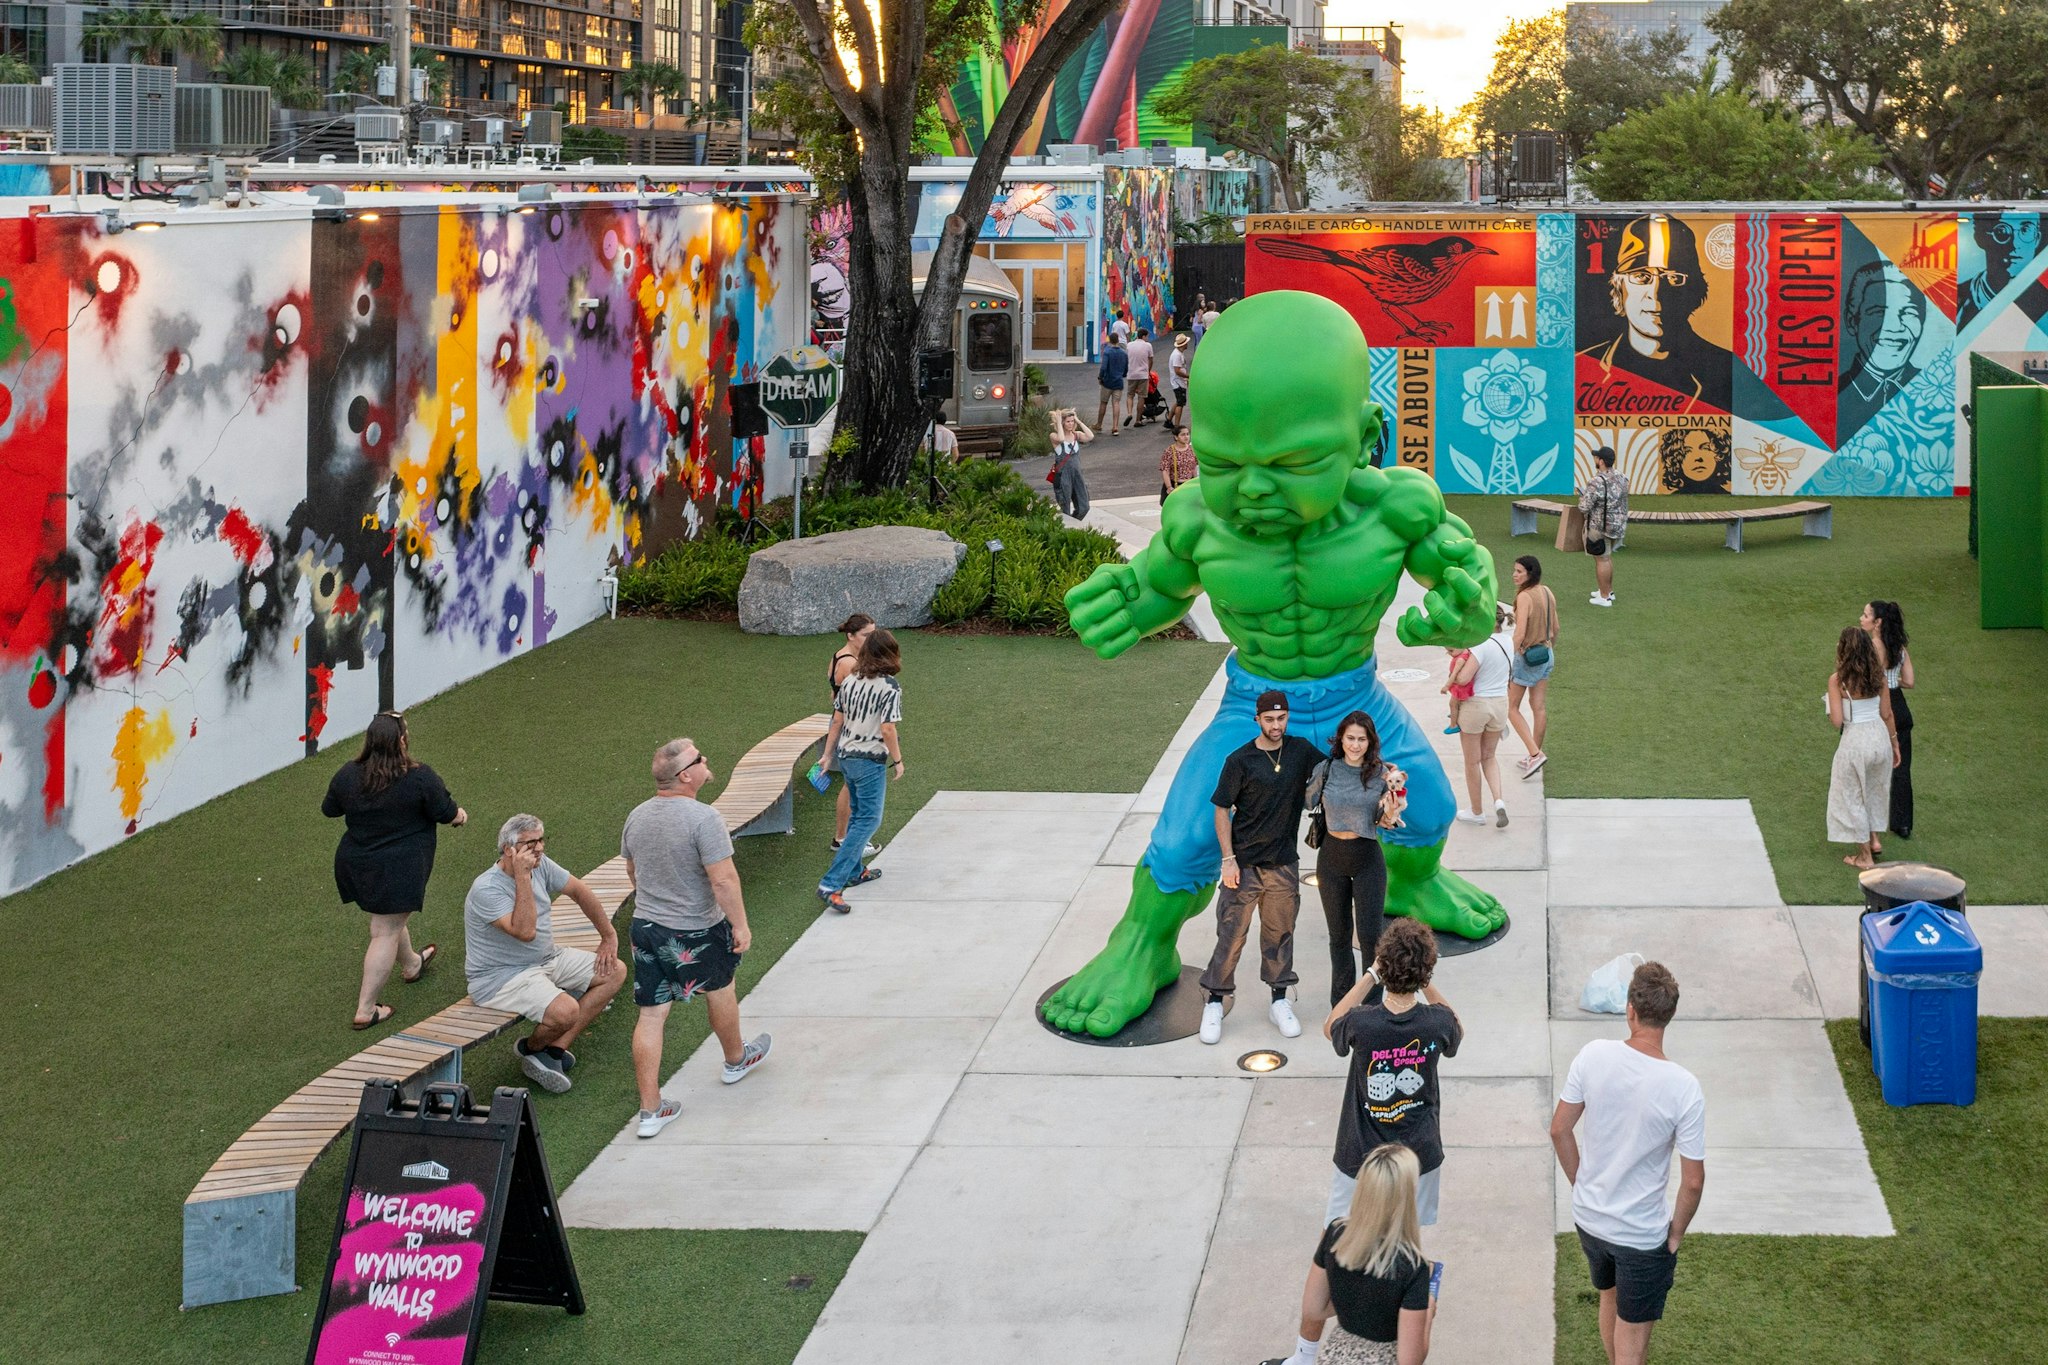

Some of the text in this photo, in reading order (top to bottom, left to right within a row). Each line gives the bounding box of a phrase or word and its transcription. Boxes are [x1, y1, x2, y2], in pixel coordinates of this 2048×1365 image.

[1253, 221, 1315, 231] FRAGILE
[1320, 221, 1373, 231] CARGO
[1383, 220, 1443, 230] HANDLE
[1448, 220, 1487, 230] WITH
[1492, 220, 1532, 230] CARE
[1586, 242, 1605, 273] 1
[1777, 224, 1836, 385] EYES OPEN
[767, 373, 832, 402] DREAM
[1577, 381, 1685, 412] Welcome
[1402, 349, 1429, 473] SE ABOVE
[1578, 415, 1732, 428] TONY GOLDMAN
[1372, 1048, 1406, 1060] DELTA
[1920, 995, 1946, 1097] RECYCLE
[364, 1192, 475, 1238] WELCOME
[404, 1231, 423, 1252] TO
[355, 1252, 463, 1283] WYNWOOD
[368, 1281, 436, 1321] WALLS
[363, 1350, 391, 1360] CONNECT
[392, 1353, 401, 1361] TO
